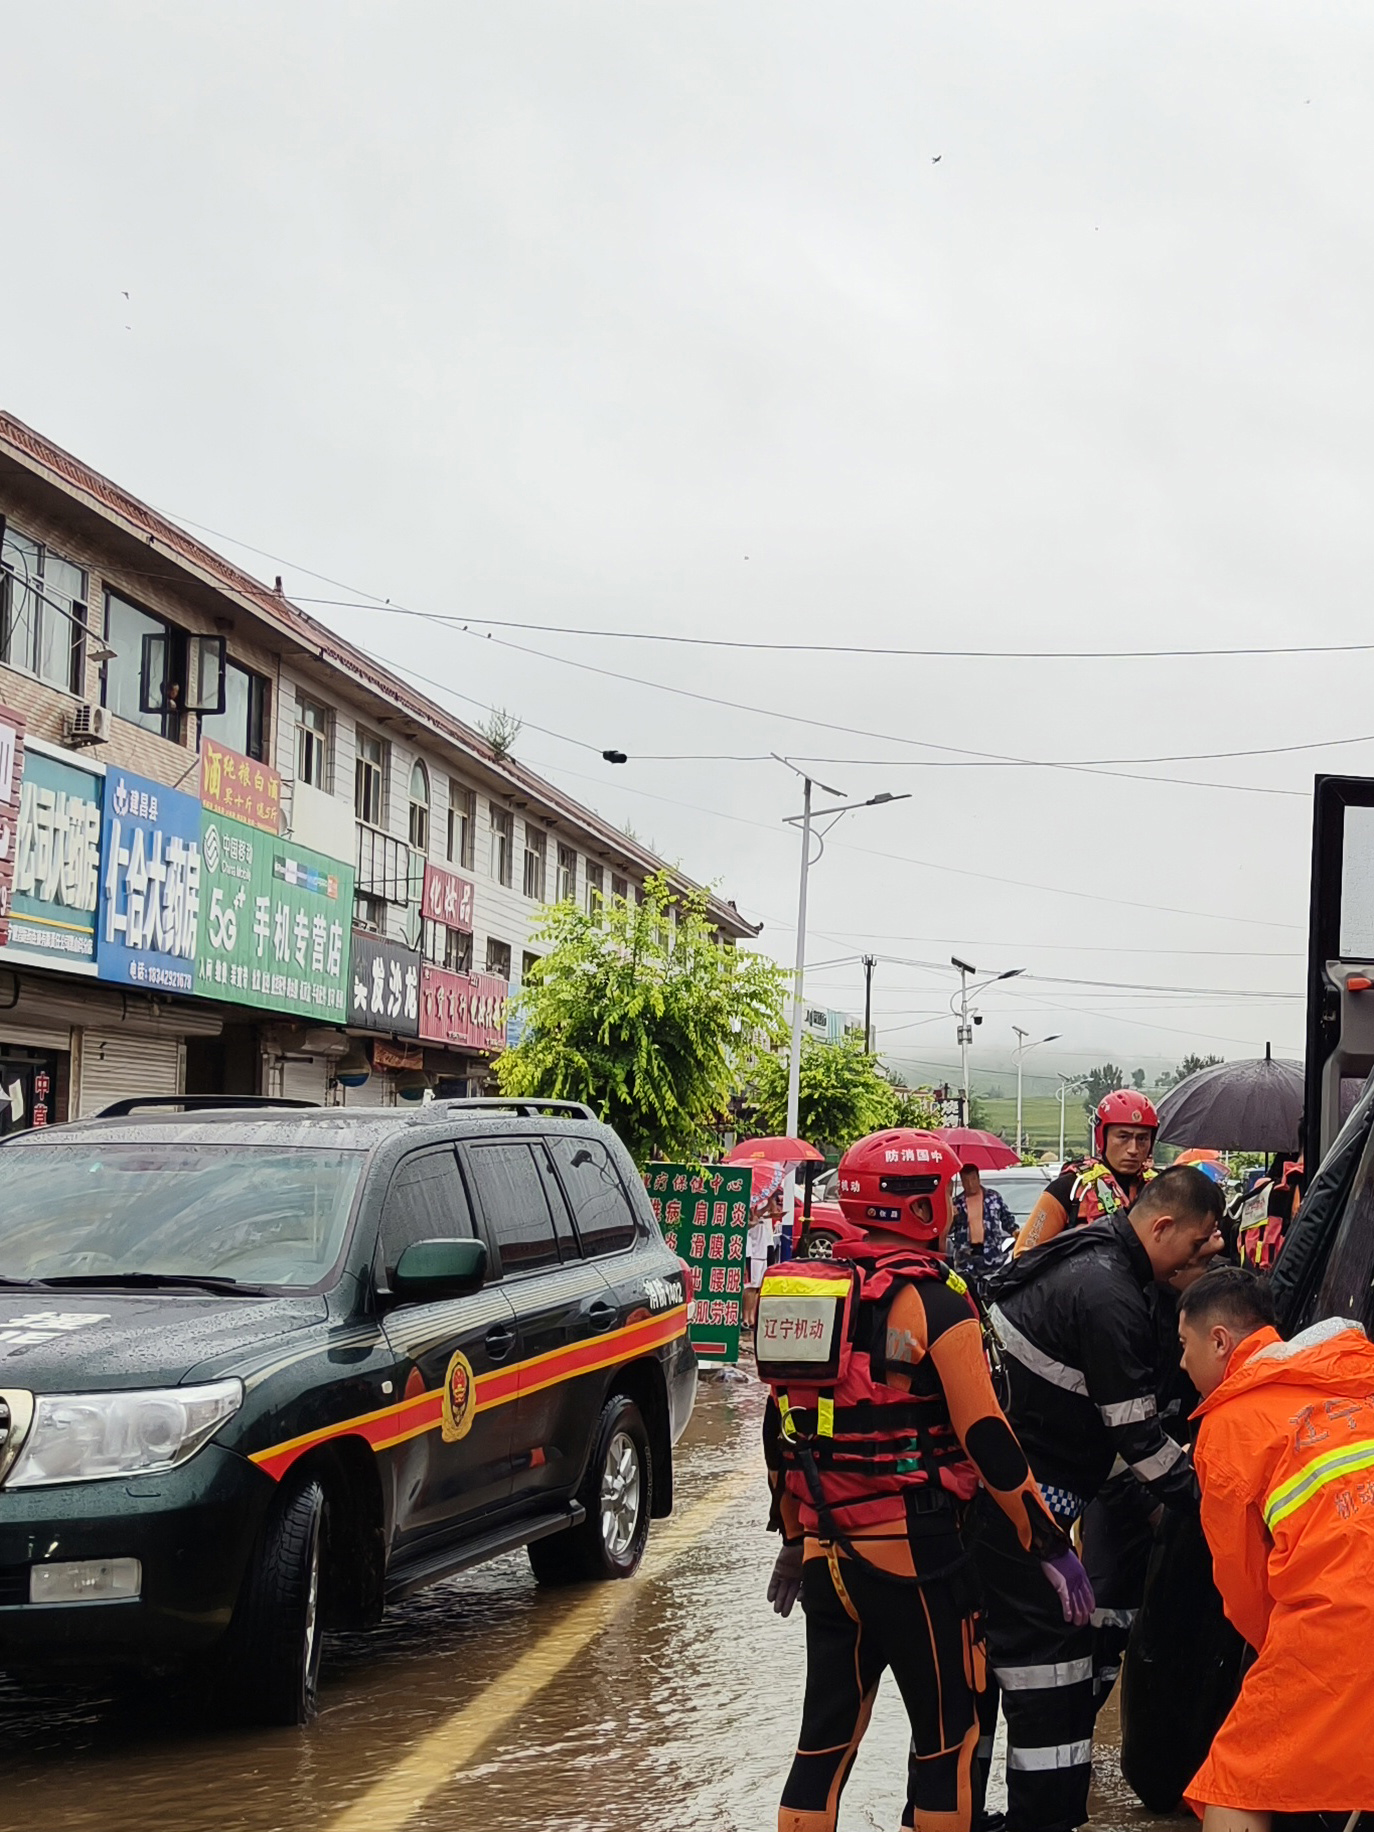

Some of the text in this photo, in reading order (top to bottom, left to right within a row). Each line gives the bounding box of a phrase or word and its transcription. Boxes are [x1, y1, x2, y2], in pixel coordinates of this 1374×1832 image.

[204, 742, 222, 800] 酒
[223, 755, 278, 801] 纯粮白酒
[128, 789, 159, 822] 建昌县
[222, 833, 253, 865] 中国移动
[105, 817, 200, 961] 仁合大药房
[429, 873, 471, 925] 化妆品
[253, 896, 343, 978] 手机专营店
[692, 1199, 747, 1228] 肩周炎
[689, 1232, 744, 1261] 滑膜炎
[709, 1267, 742, 1293] 腰脱
[689, 1299, 740, 1326] 肌劳损
[763, 1317, 825, 1341] 辽宁机动
